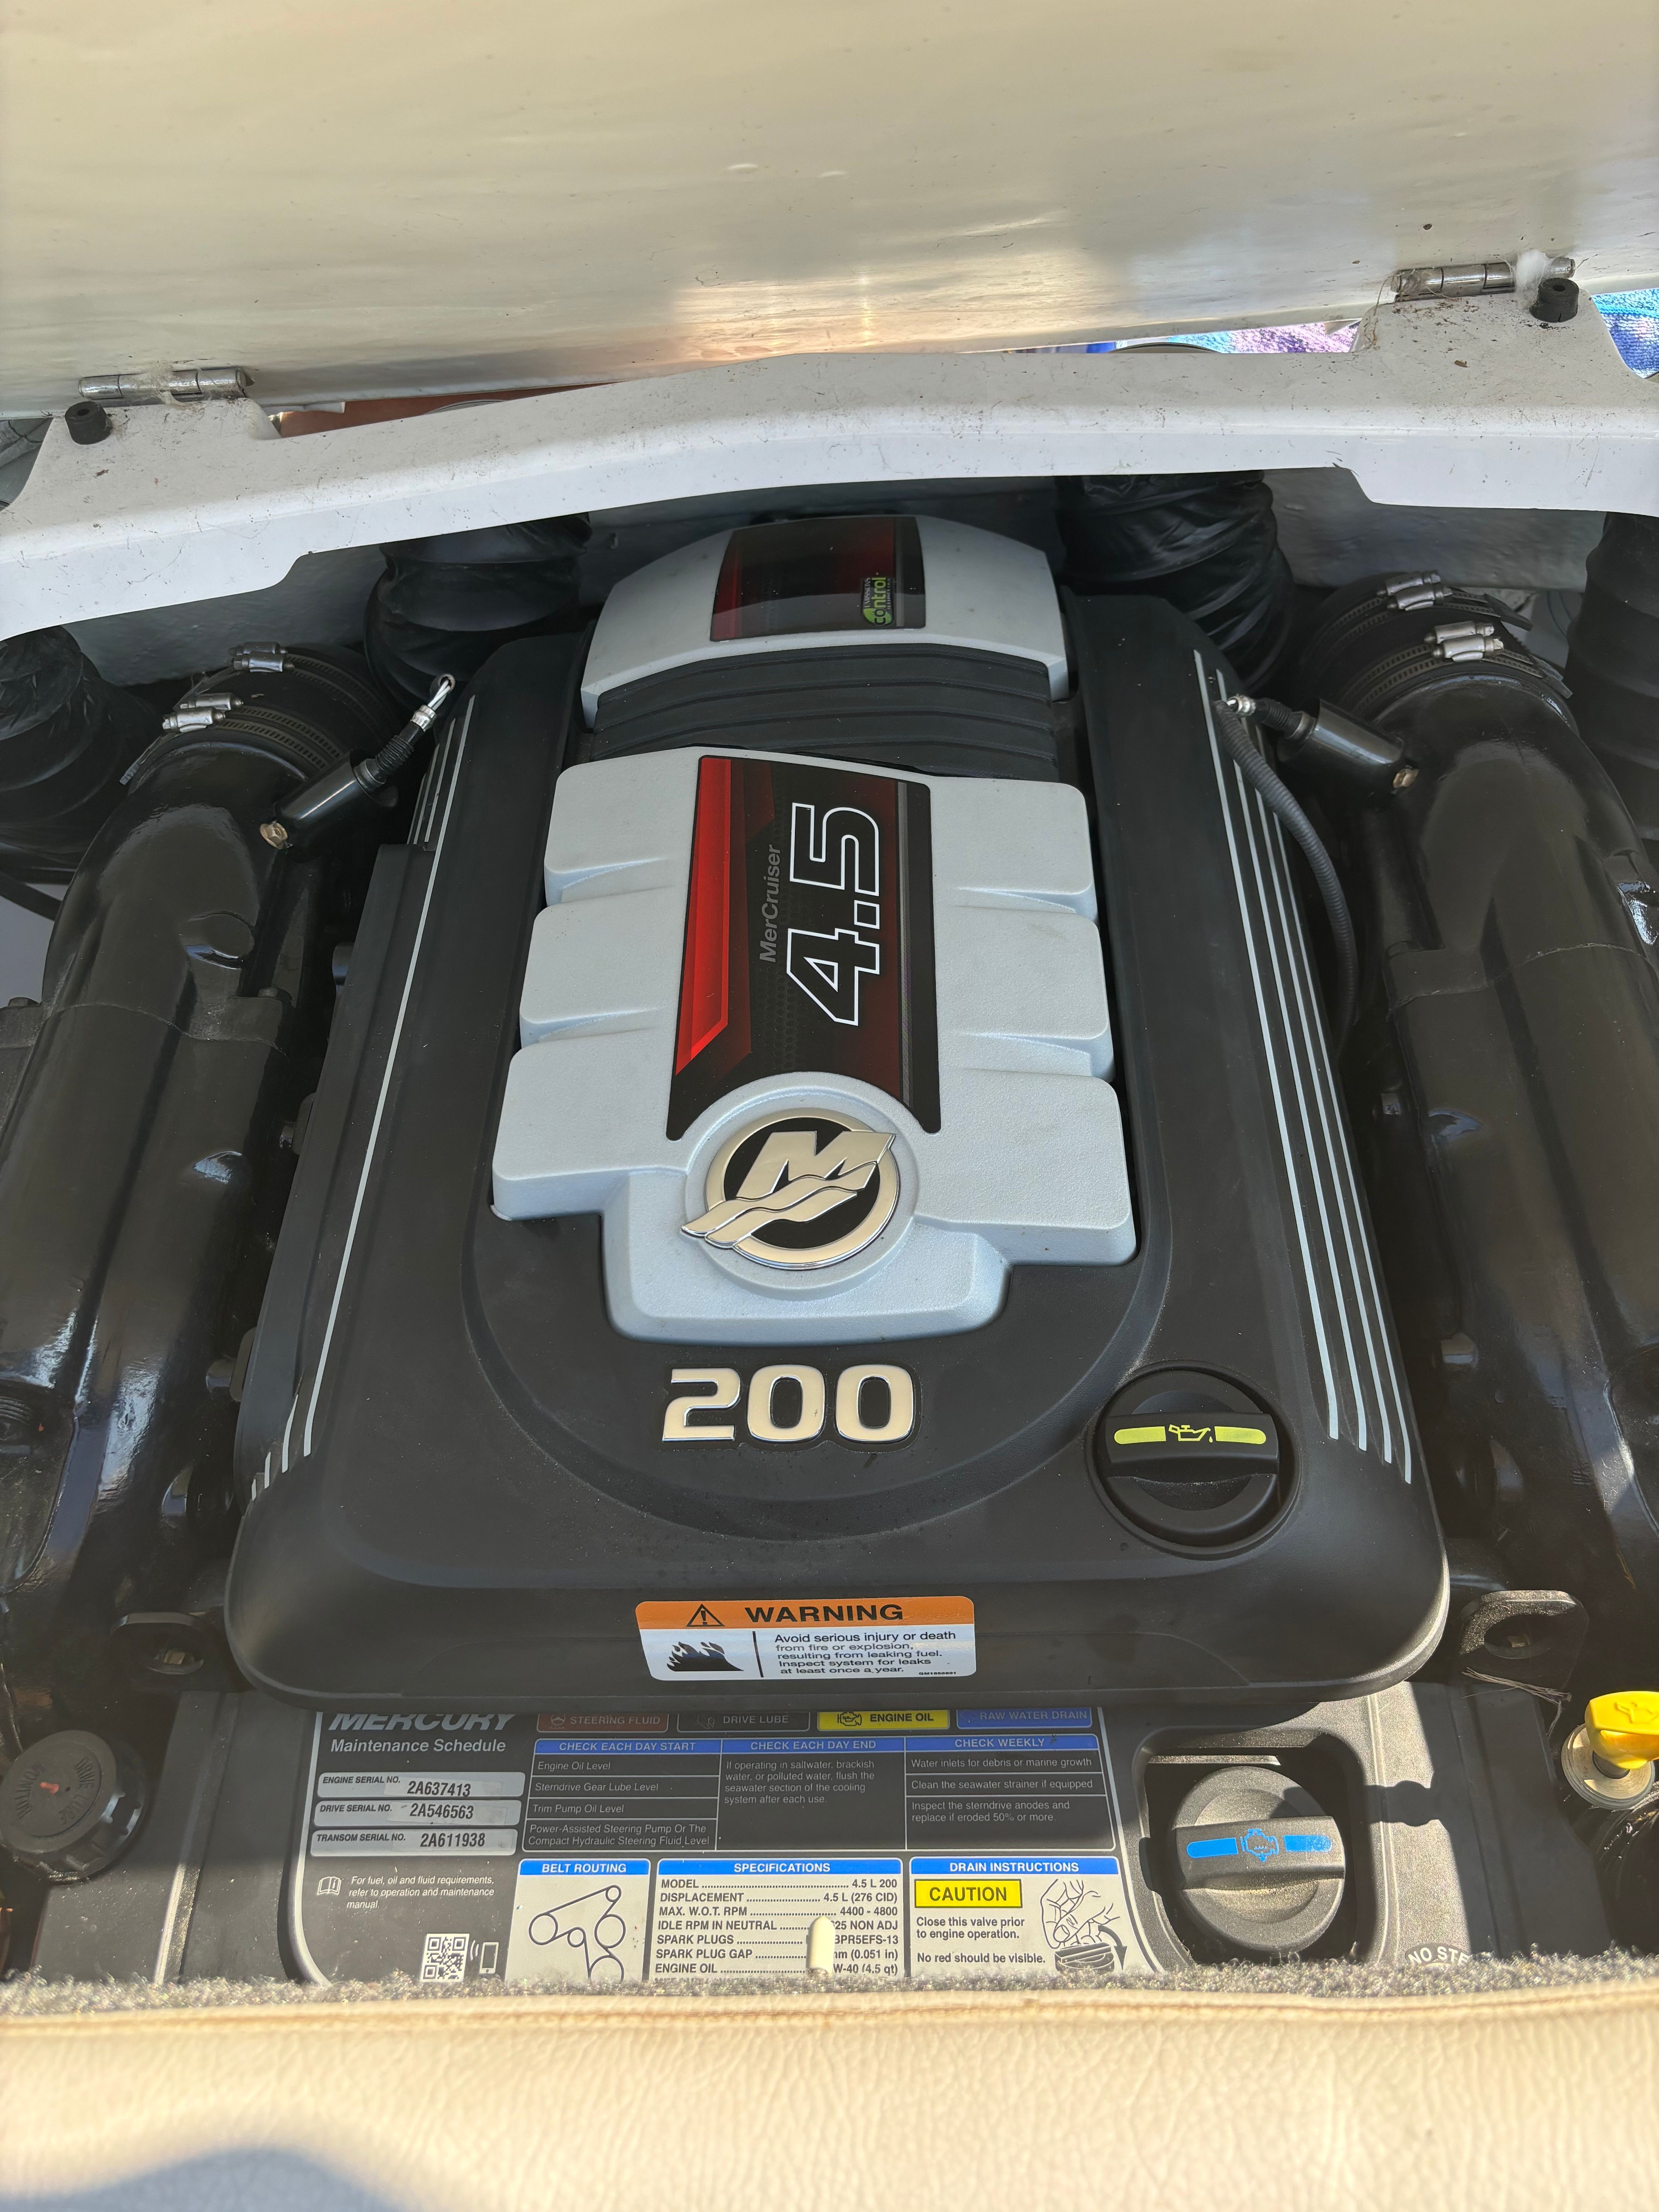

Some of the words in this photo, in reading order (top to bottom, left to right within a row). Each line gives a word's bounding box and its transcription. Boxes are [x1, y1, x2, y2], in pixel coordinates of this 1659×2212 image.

[871, 577, 886, 625] control
[759, 844, 781, 963] MerCruiser
[787, 802, 879, 1026] 4.5
[663, 1364, 914, 1444] 200
[744, 1604, 903, 1623] WARNING
[775, 1634, 810, 1642] Avoid
[814, 1633, 860, 1642] serious
[864, 1632, 899, 1642] injury
[920, 1631, 956, 1640] death
[849, 1643, 913, 1652] explosion,
[777, 1652, 831, 1660] resulting
[867, 1650, 912, 1659] leaking
[570, 1716, 625, 1724] STEERING
[760, 1715, 788, 1723] LUBE
[870, 1713, 912, 1722] ENGINE
[915, 1712, 934, 1721] OIL
[1009, 1711, 1048, 1719] WATER
[1052, 1711, 1087, 1719] DRAIN
[328, 1713, 516, 1730] MERCURY
[331, 1739, 429, 1752] Maintenance
[433, 1738, 506, 1752] Schedule
[559, 1742, 598, 1751] CHECK
[601, 1742, 632, 1751] EACH
[660, 1742, 696, 1750] START
[750, 1741, 789, 1750] CHECK
[793, 1741, 824, 1749] EACH
[828, 1741, 849, 1749] DAY
[853, 1740, 876, 1749] END
[955, 1738, 994, 1747] CHECK
[998, 1738, 1044, 1747] WEEKLY
[538, 1762, 568, 1772] Engine
[572, 1761, 584, 1770] Oil
[587, 1762, 610, 1770] Level
[726, 1761, 732, 1769] If
[735, 1762, 776, 1771] operating
[791, 1760, 833, 1769] saltwater,
[836, 1760, 874, 1768] brackish
[911, 1759, 938, 1767] Water
[941, 1759, 965, 1767] inlets
[968, 1759, 979, 1767] for
[983, 1758, 1011, 1767] debris
[1061, 1758, 1091, 1768] growth
[407, 1781, 471, 1797] 2A637413
[535, 1783, 580, 1791] Sterndrive
[584, 1783, 606, 1791] Gear
[609, 1783, 631, 1791] Lube
[634, 1783, 658, 1791] Level
[409, 1803, 474, 1819] 2A546563
[530, 1824, 601, 1833] Power-Assisted
[604, 1824, 642, 1835] Steering
[645, 1824, 672, 1835] Pump
[675, 1824, 686, 1832] Or
[689, 1824, 706, 1832] The
[317, 1834, 358, 1842] TRANSOM
[420, 1832, 485, 1847] 2A611938
[542, 1863, 571, 1873] BELT
[574, 1863, 626, 1873] ROUTING
[734, 1863, 830, 1872] SPECIFICATIONS
[950, 1862, 987, 1872] DRAIN
[990, 1862, 1079, 1872] INSTRUCTIONS
[351, 1876, 366, 1884] For
[368, 1876, 385, 1886] fuel,
[388, 1875, 398, 1884] oil
[399, 1876, 416, 1884] and
[418, 1875, 435, 1884] fluid
[437, 1875, 494, 1886] requirements,
[661, 1879, 699, 1888] MODEL
[852, 1879, 867, 1888] 4.5
[870, 1879, 877, 1888] L
[879, 1879, 897, 1888] 200
[660, 1893, 744, 1902] DISPLACEMENT
[823, 1893, 838, 1902] 4.5
[842, 1892, 848, 1902] L
[851, 1892, 872, 1904] (276
[876, 1892, 897, 1904] CID)
[929, 1887, 1006, 1901] CAUTION
[659, 1906, 685, 1916] MAX.
[689, 1906, 720, 1916] W.O.T.
[723, 1906, 747, 1916] RPM
[840, 1906, 864, 1916] 4400
[874, 1906, 898, 1916] 4800
[658, 1920, 682, 1930] IDLE
[685, 1920, 709, 1930] RPM
[712, 1920, 723, 1930] IN
[726, 1920, 777, 1930] NEUTRAL
[831, 1920, 847, 1930] 25
[850, 1920, 874, 1930] NON
[877, 1920, 898, 1930] ADJ
[916, 1917, 946, 1926] Close
[948, 1917, 967, 1926] this
[970, 1917, 998, 1927] valve
[1000, 1917, 1025, 1930] prior
[657, 1934, 694, 1944] SPARK
[697, 1934, 734, 1944] PLUGS
[916, 1929, 927, 1938] to
[929, 1929, 965, 1941] engine
[967, 1929, 1019, 1941] operation.
[656, 1949, 693, 1959] SPARK
[696, 1949, 726, 1959] PLUG
[729, 1949, 753, 1959] GAP
[851, 1949, 880, 1961] (0.051
[885, 1949, 898, 1961] in)
[917, 1953, 931, 1963] No
[935, 1953, 951, 1963] red
[954, 1953, 990, 1963] should
[993, 1953, 1006, 1963] be
[1008, 1953, 1045, 1963] visible.
[1408, 1947, 1432, 1964] NO
[1437, 1946, 1470, 1966] STE
[655, 1963, 697, 1973] ENGINE
[699, 1963, 718, 1973] OIL
[884, 1963, 898, 1976] qt)
